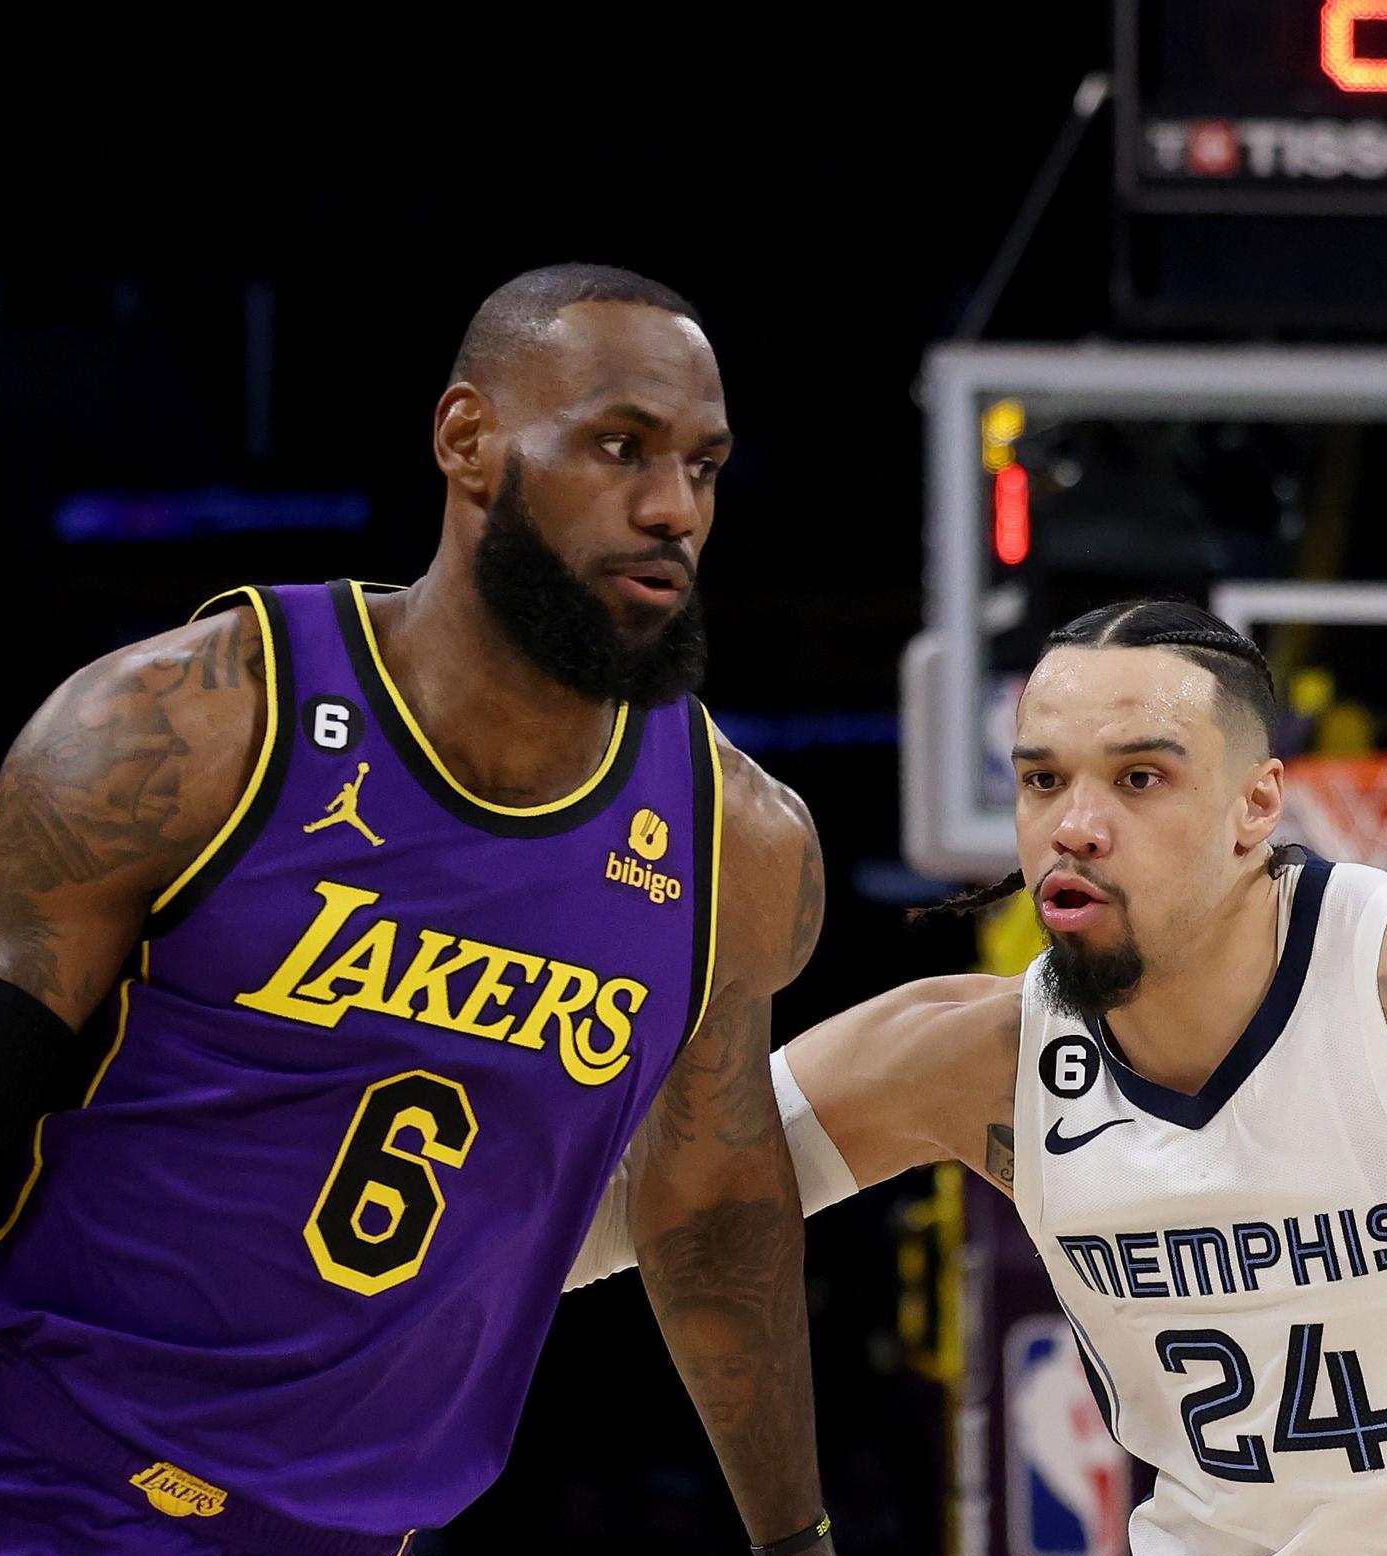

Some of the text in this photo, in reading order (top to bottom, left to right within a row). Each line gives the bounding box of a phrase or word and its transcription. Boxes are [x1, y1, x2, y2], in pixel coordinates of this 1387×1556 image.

[313, 703, 350, 749] 6
[605, 852, 682, 904] bibigo
[234, 879, 649, 1087] LAKERS
[1054, 1043, 1088, 1091] 6
[302, 1068, 479, 1297] 6
[139, 1467, 221, 1514] LAKERS
